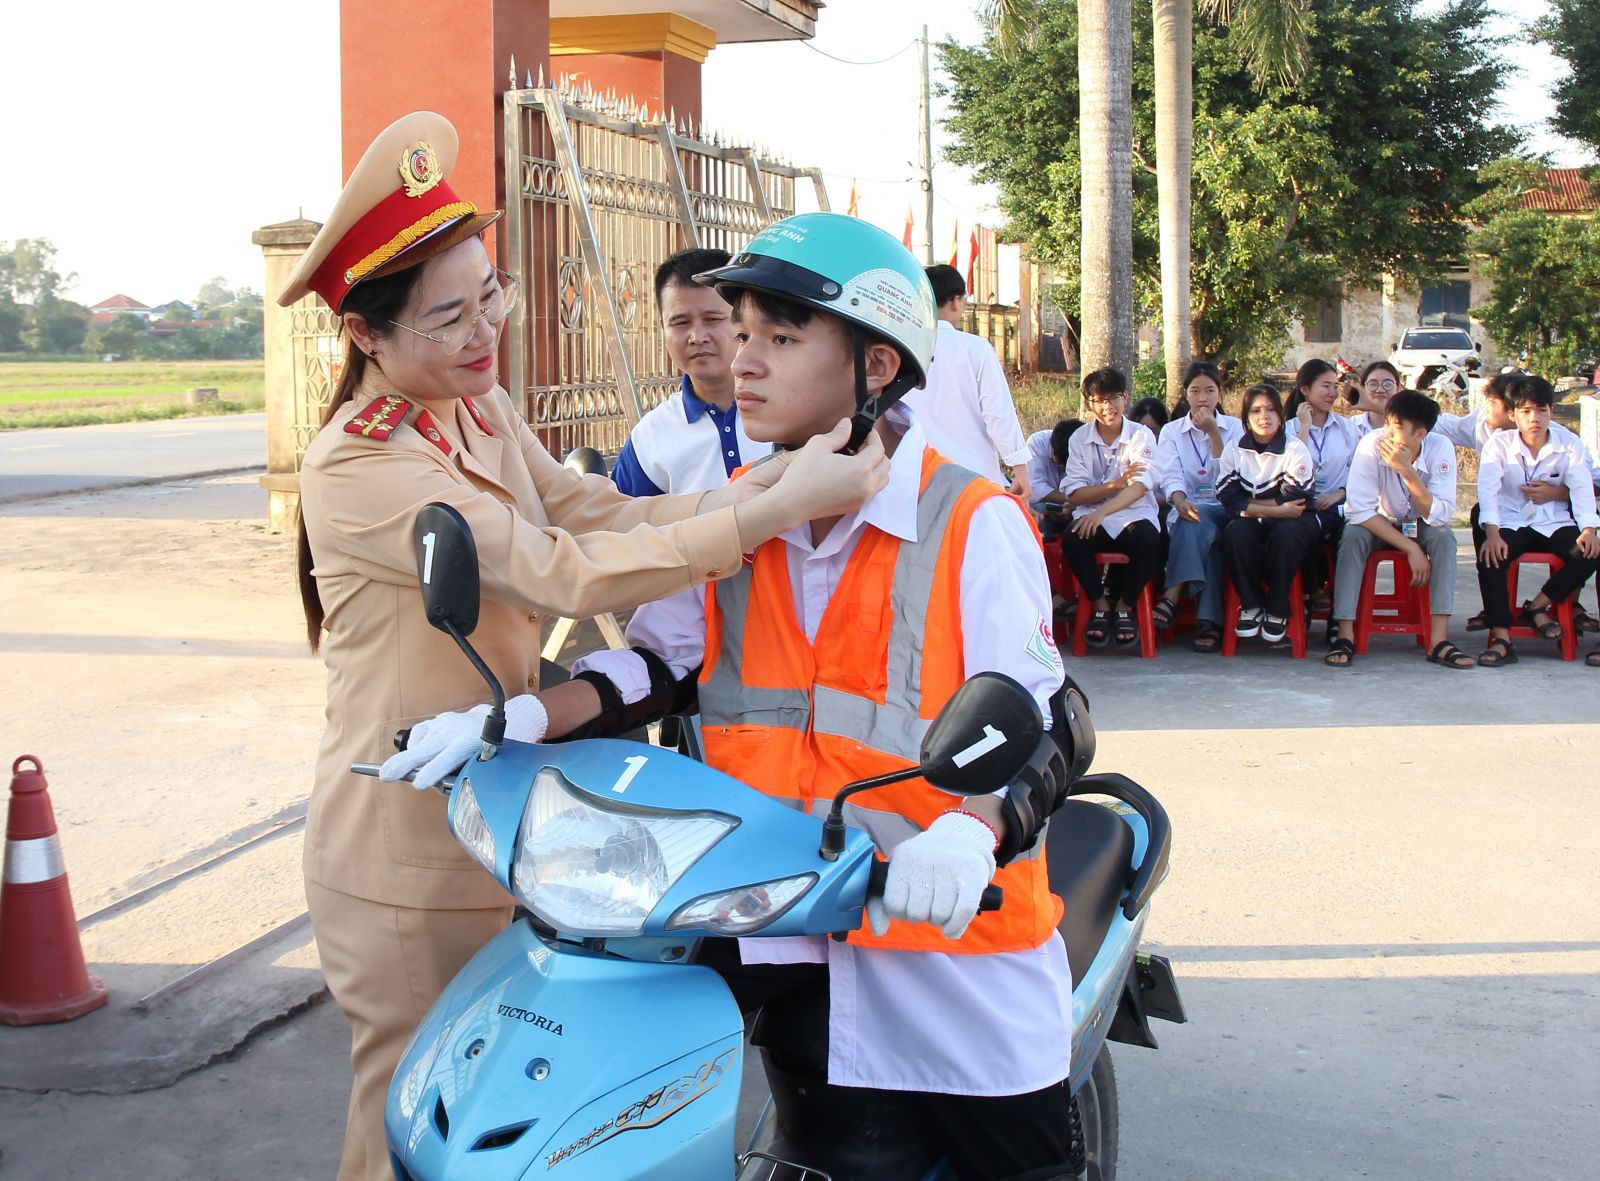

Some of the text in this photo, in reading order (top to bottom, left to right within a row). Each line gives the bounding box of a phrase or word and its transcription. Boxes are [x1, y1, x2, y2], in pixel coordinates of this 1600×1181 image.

[778, 229, 806, 243] ANH
[877, 285, 899, 299] QUANG
[899, 298, 913, 308] ANH
[423, 532, 436, 584] 1
[952, 724, 1008, 769] 1
[612, 755, 649, 794] 1
[497, 1004, 564, 1036] VICTORIA
